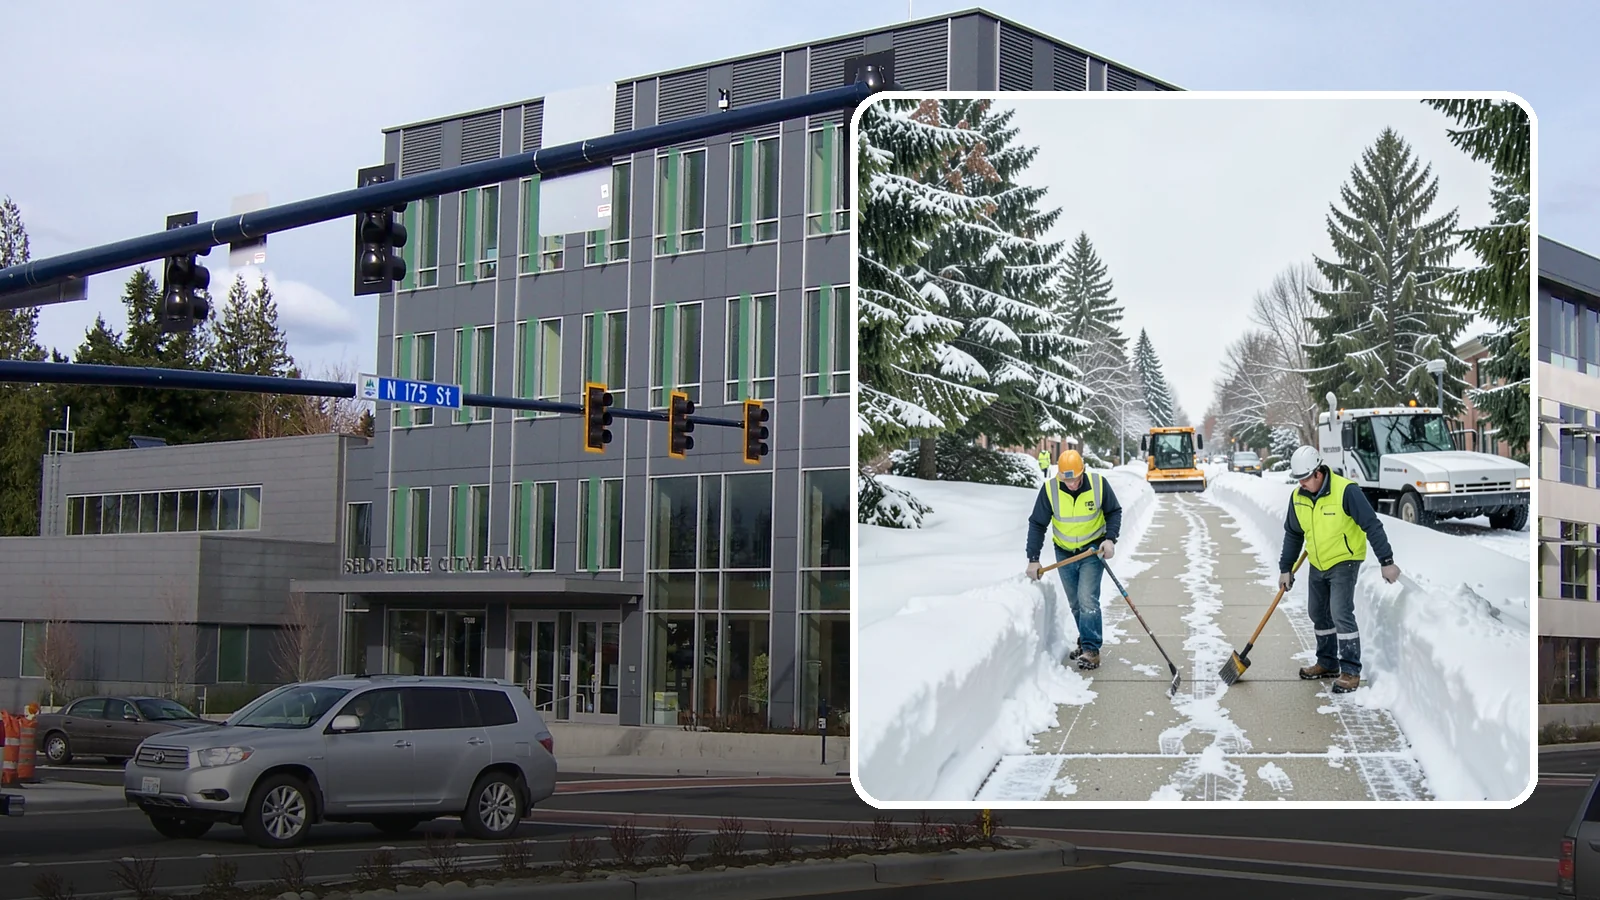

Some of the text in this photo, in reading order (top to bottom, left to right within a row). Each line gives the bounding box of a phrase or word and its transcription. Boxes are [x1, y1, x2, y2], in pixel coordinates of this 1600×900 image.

[387, 380, 451, 406] N 175 St
[343, 555, 525, 574] SHORELINE CITY HALL
